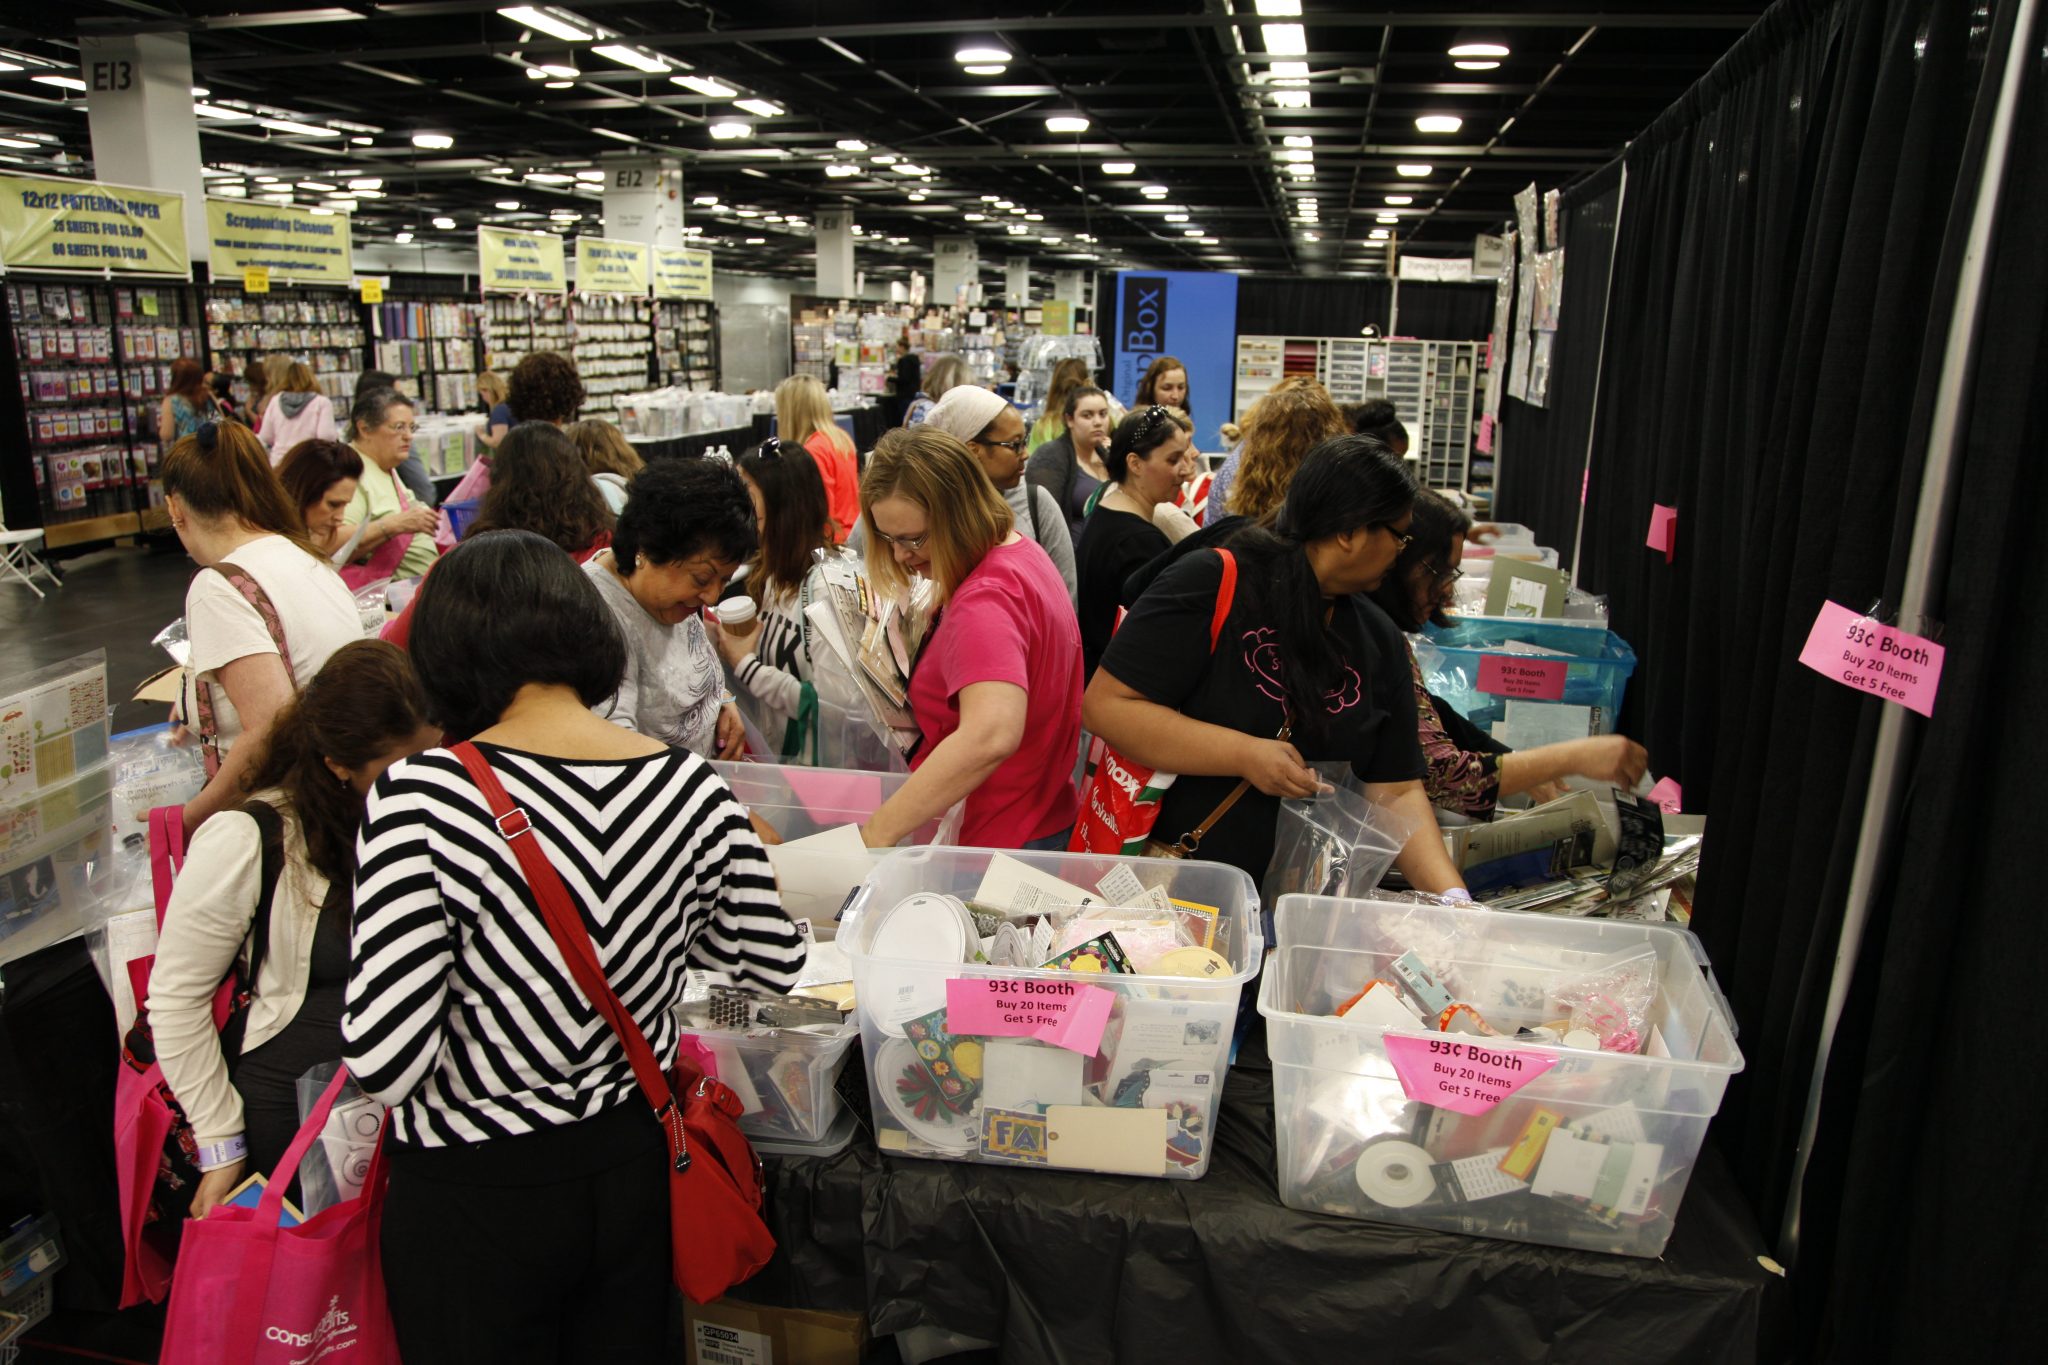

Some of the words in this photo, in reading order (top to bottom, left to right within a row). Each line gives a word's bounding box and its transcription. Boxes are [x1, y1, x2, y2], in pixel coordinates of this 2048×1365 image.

[93, 61, 131, 91] E13
[616, 170, 643, 187] E12
[22, 191, 58, 209] 12x12
[127, 201, 160, 219] PAPER
[67, 220, 100, 234] SHEETS
[102, 222, 118, 235] FOR
[67, 243, 100, 257] SHEETS
[102, 245, 121, 258] FOR
[1846, 625, 1875, 648] 93¢
[1880, 636, 1929, 667] Booth
[1519, 668, 1546, 678] Booth
[1842, 650, 1865, 668] Buy
[1867, 658, 1885, 672] 20
[1887, 664, 1918, 685] Items
[1843, 670, 1866, 686] Get
[1869, 678, 1877, 689] 5
[1880, 681, 1906, 700] Free
[989, 980, 1019, 994] 93¢
[1024, 981, 1074, 996] Booth
[996, 1000, 1017, 1011] Buy
[1020, 1001, 1034, 1010] 20
[1037, 1001, 1067, 1012] Items
[1004, 1014, 1024, 1024] Get
[1027, 1015, 1033, 1024] 5
[1037, 1015, 1058, 1027] Free
[1429, 1040, 1462, 1058] 93¢
[1467, 1045, 1522, 1072] Booth
[1433, 1062, 1457, 1078] Buy
[1460, 1067, 1475, 1080] 20
[1477, 1072, 1512, 1089] Items
[1439, 1080, 1460, 1095] Get
[1463, 1086, 1470, 1097] 5
[1474, 1088, 1501, 1103] Free
[996, 1120, 1047, 1151] FA
